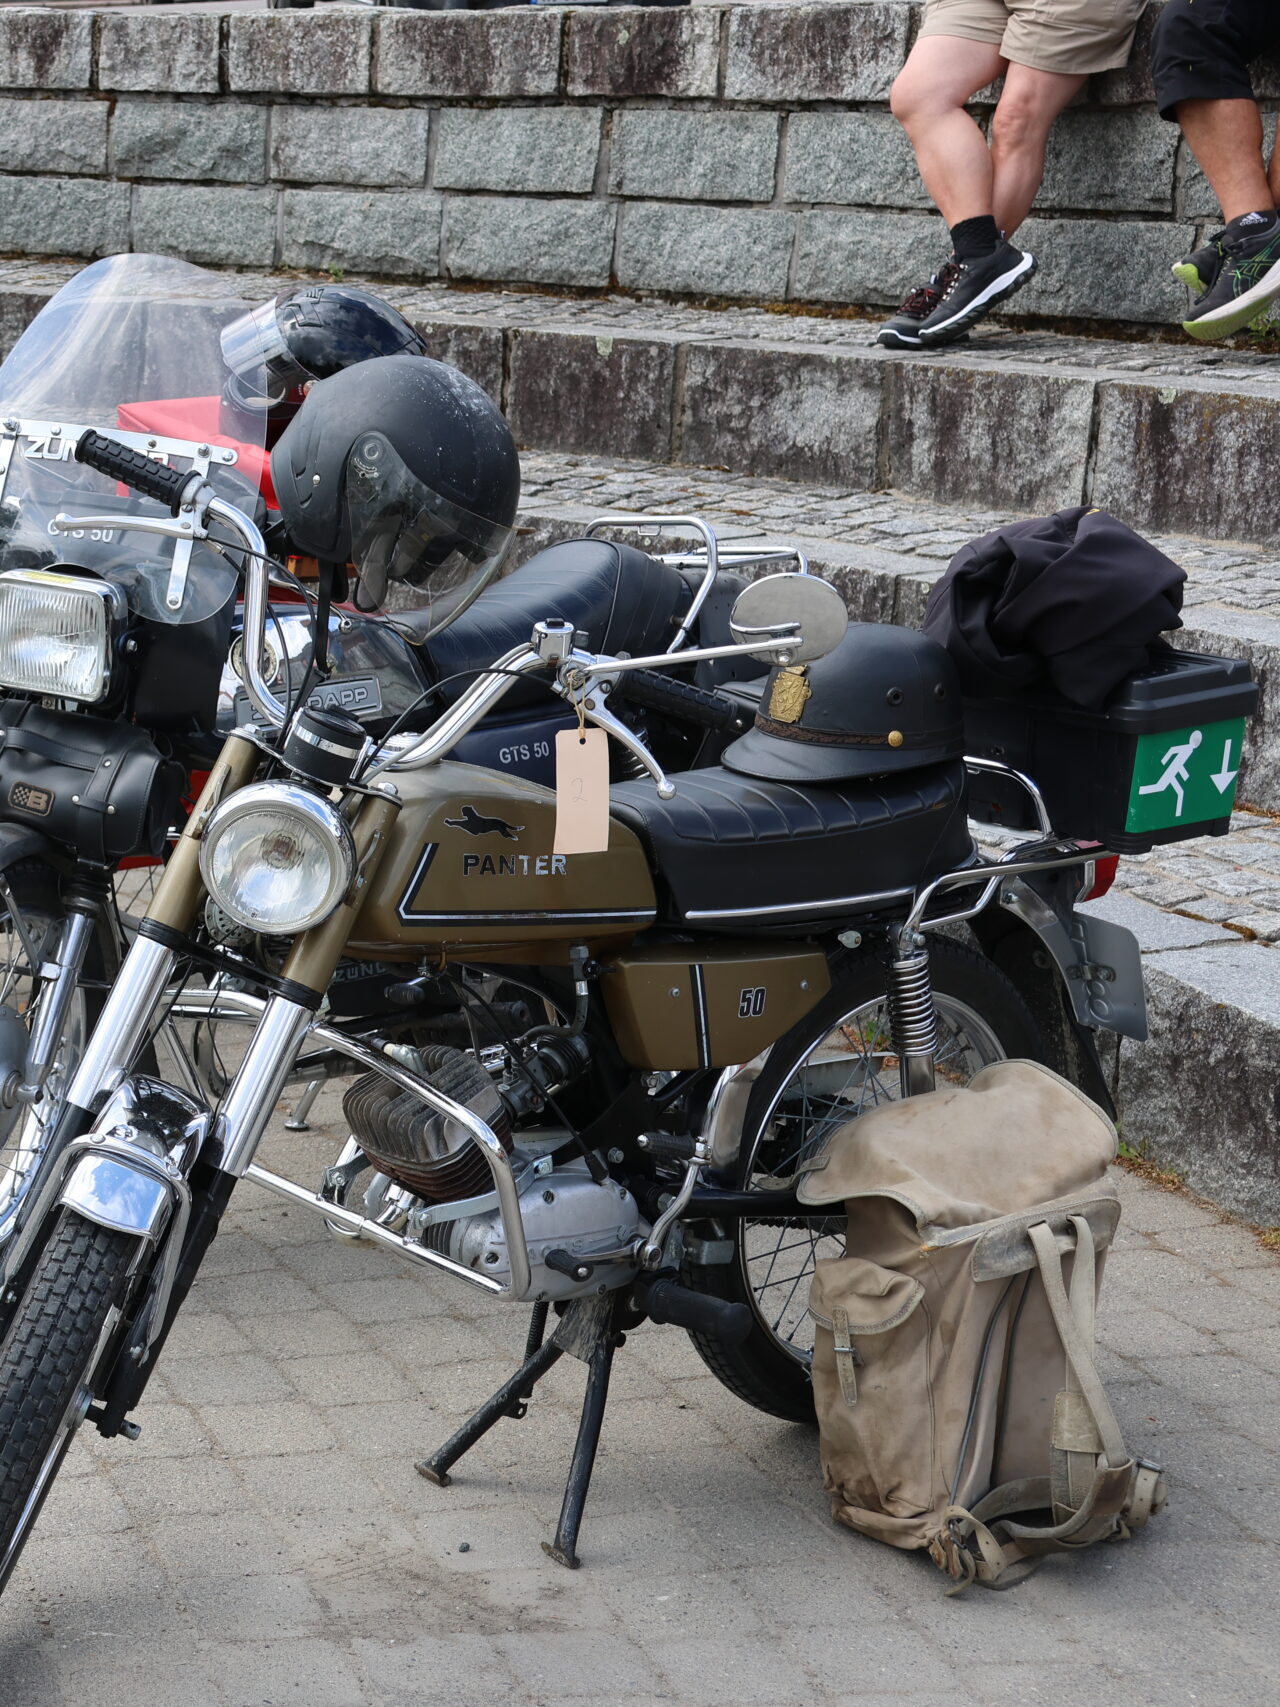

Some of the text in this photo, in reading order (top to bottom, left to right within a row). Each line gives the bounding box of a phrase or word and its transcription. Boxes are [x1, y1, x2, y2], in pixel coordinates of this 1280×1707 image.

[499, 741, 550, 764] GTS 50
[463, 853, 568, 877] PANTER
[738, 986, 767, 1018] 50
